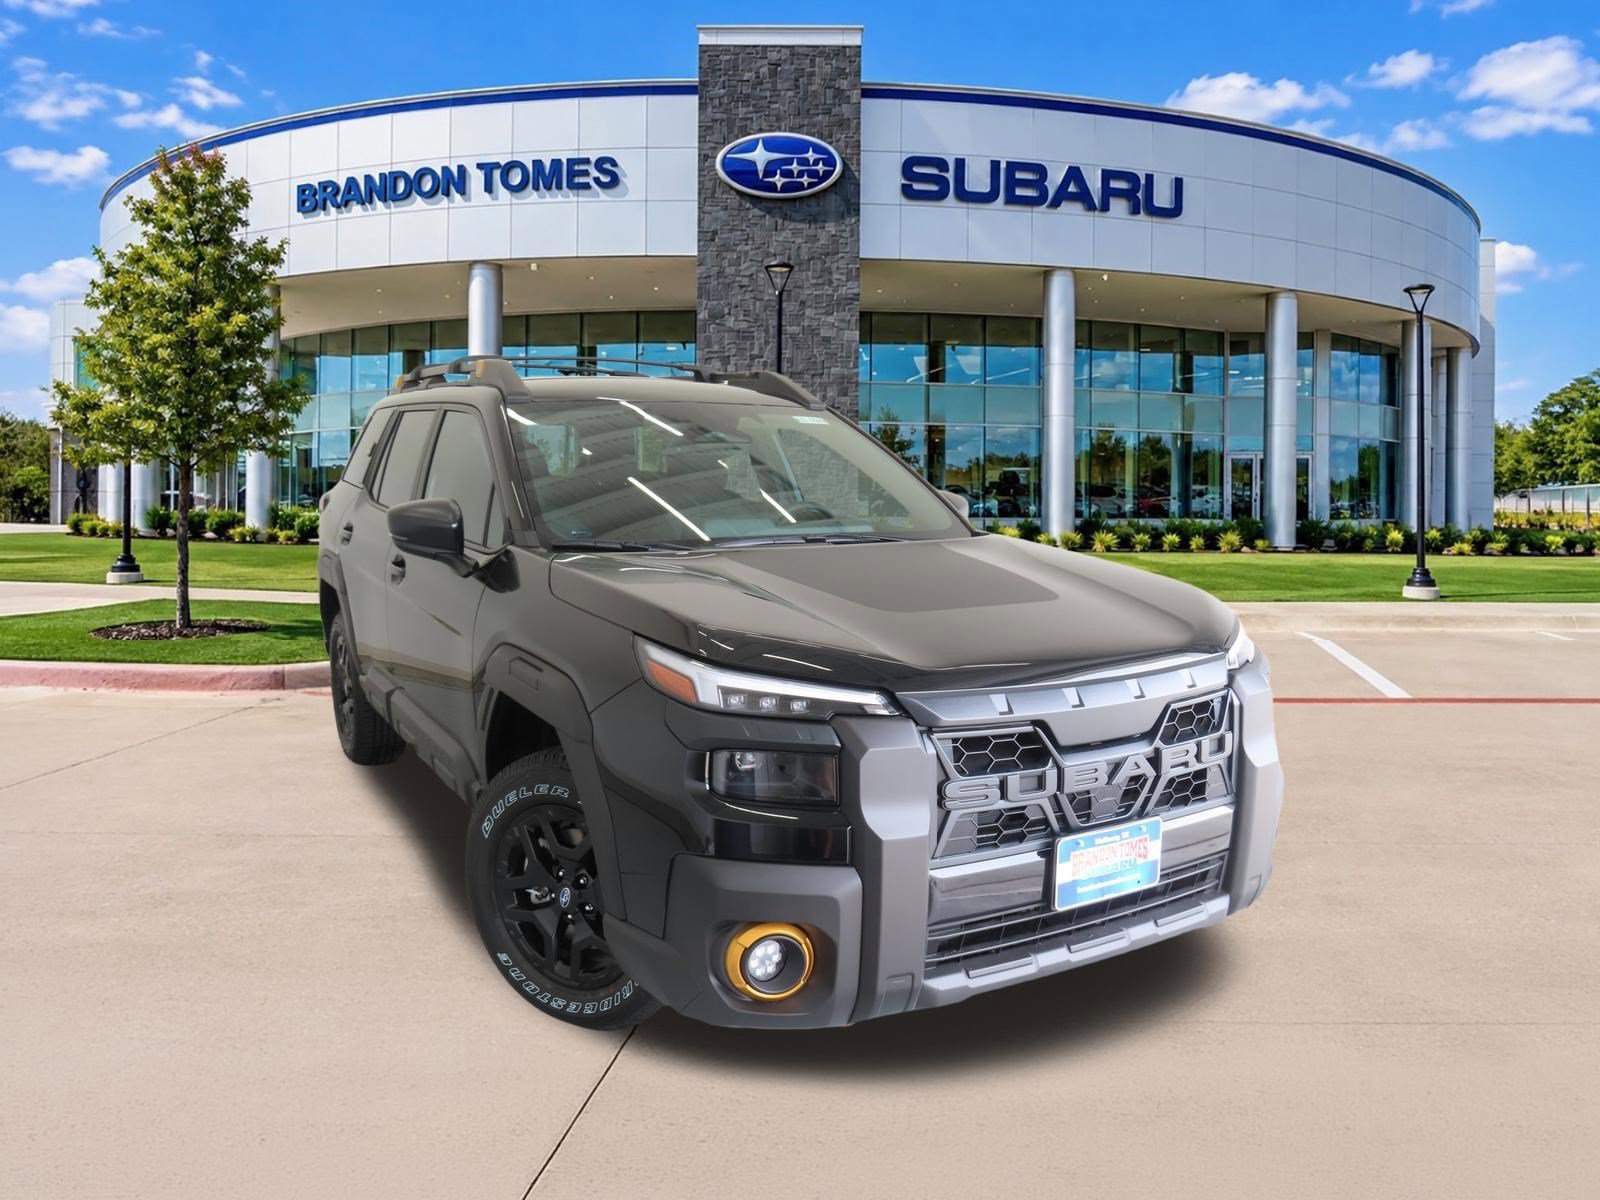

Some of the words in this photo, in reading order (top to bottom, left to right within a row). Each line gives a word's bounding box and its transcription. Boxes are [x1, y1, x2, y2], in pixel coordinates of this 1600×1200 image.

[296, 163, 467, 214] BRANDON
[476, 155, 621, 193] TOMES
[900, 155, 1184, 218] SUBARU
[942, 730, 1233, 810] SUBARU
[481, 783, 570, 839] DUELER
[1071, 845, 1118, 877] BRANDON
[1118, 836, 1149, 861] TOMES
[496, 952, 639, 1014] RIDGESTONE
